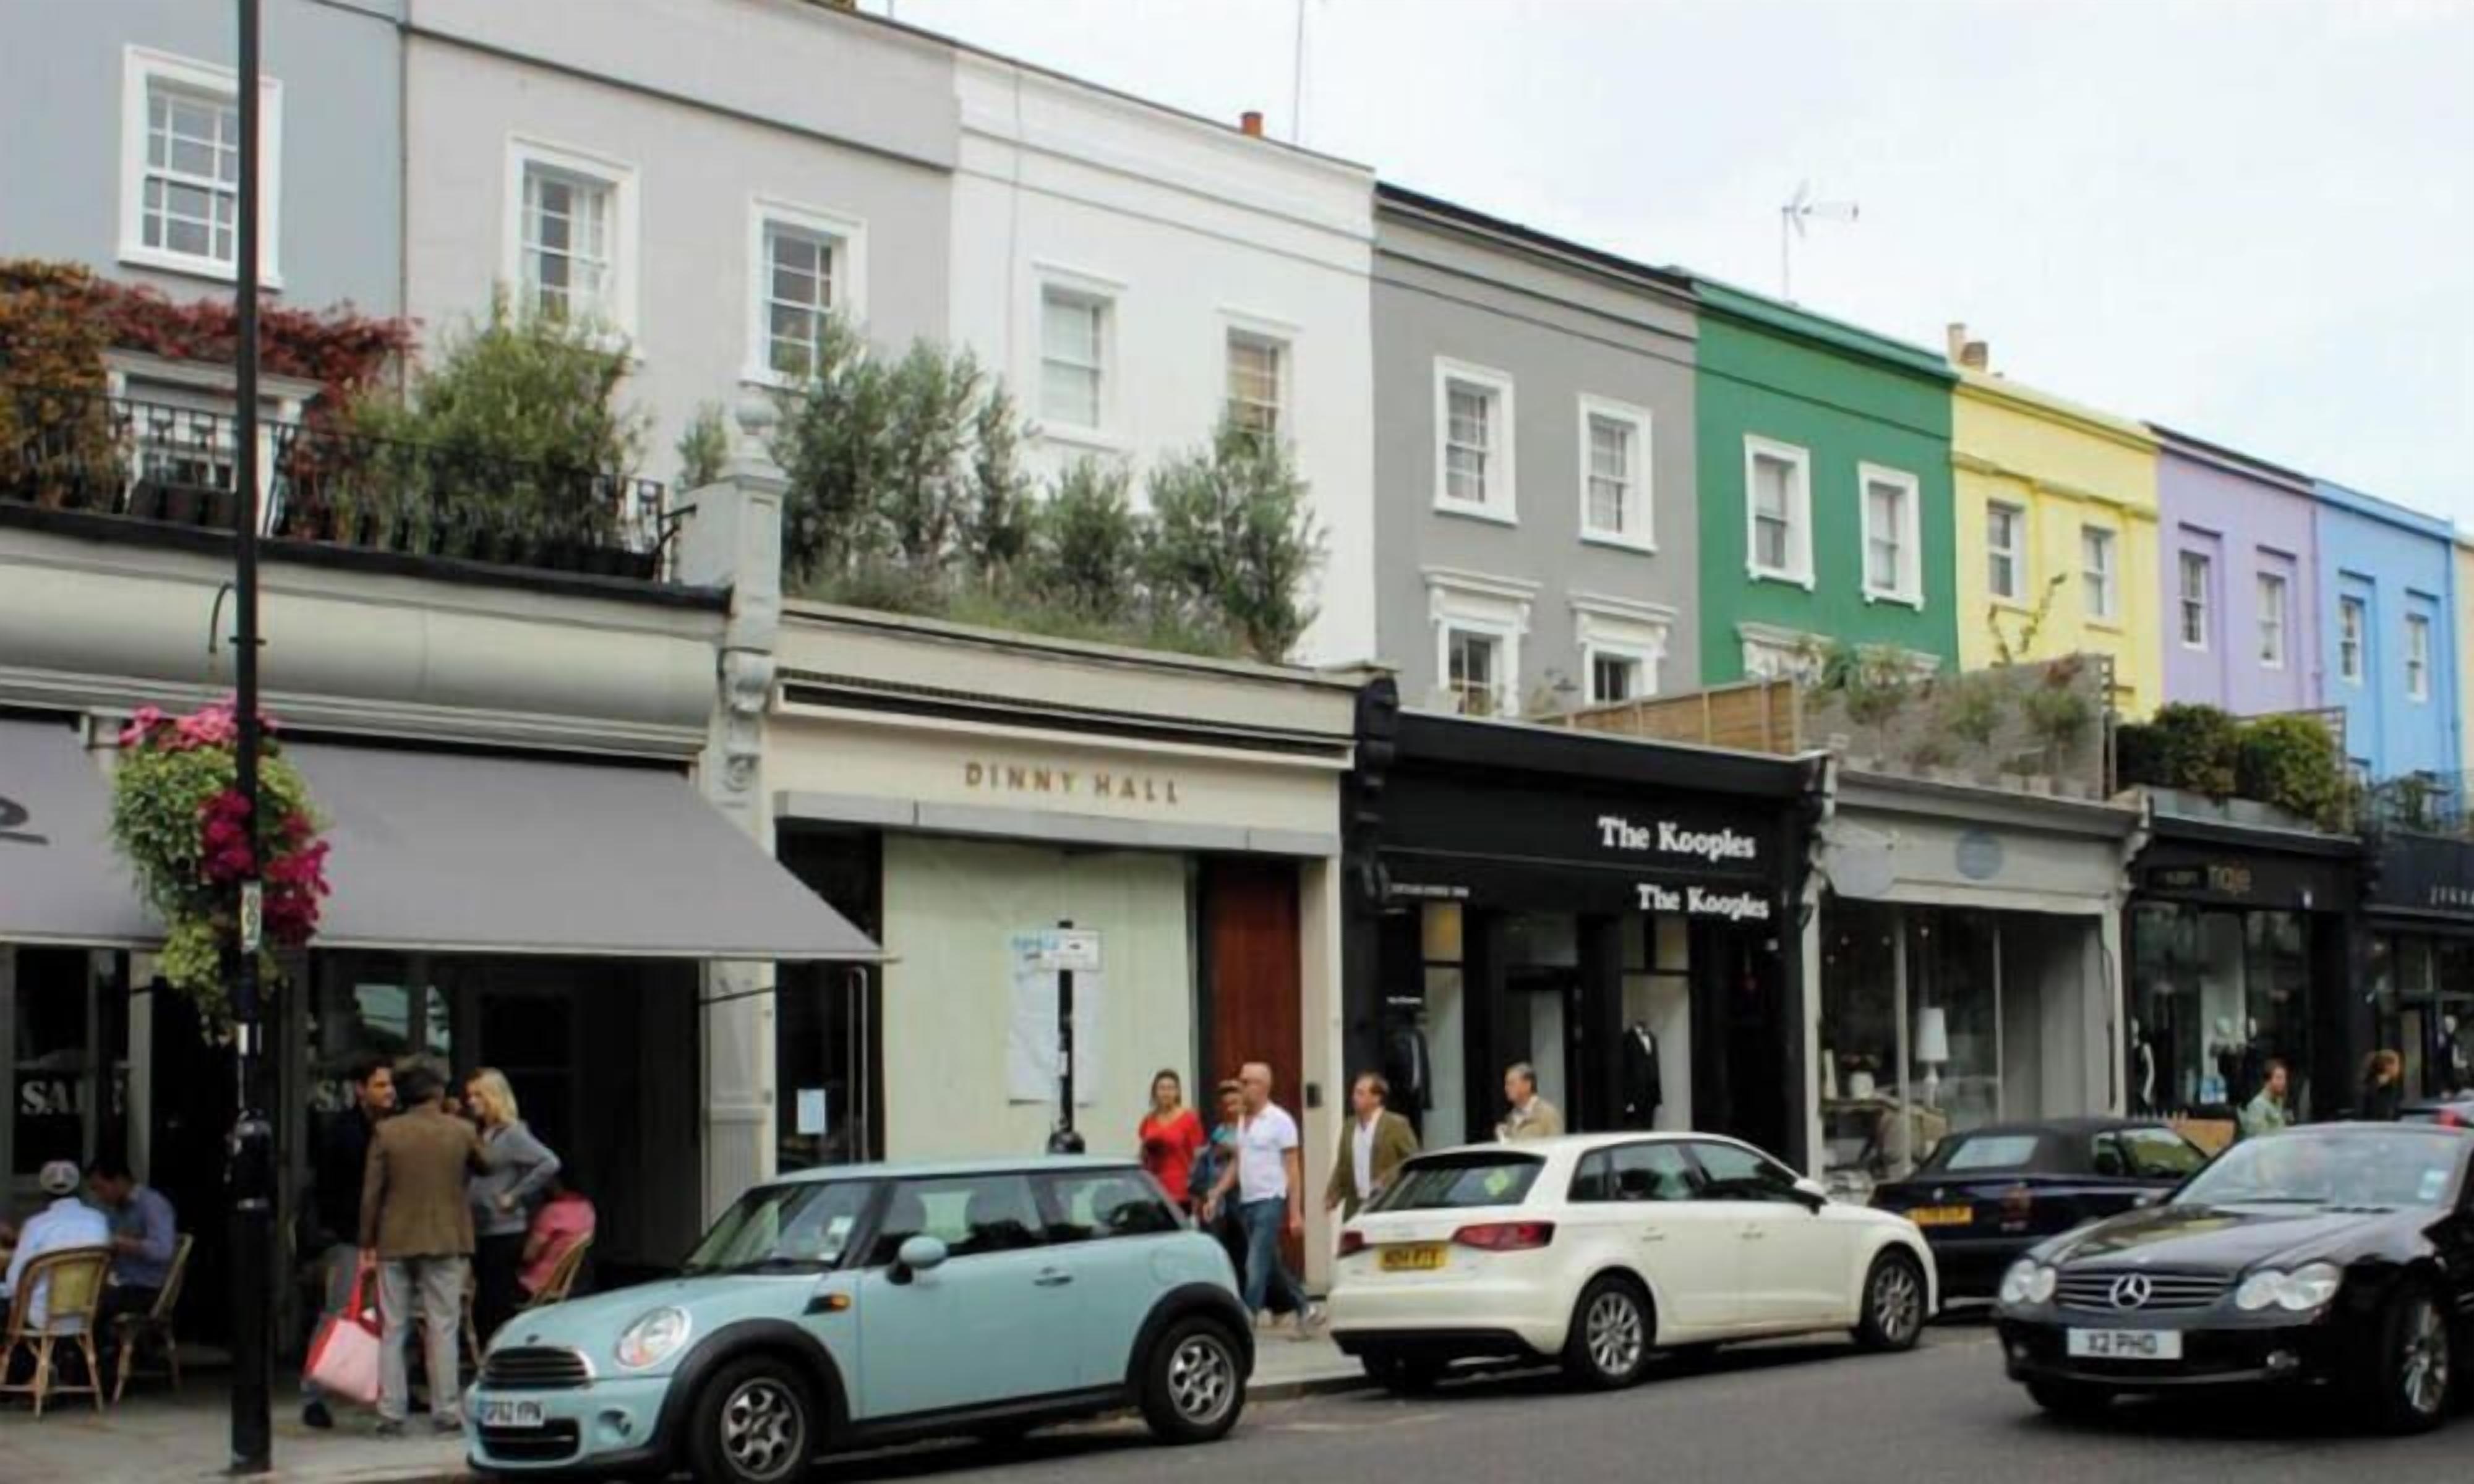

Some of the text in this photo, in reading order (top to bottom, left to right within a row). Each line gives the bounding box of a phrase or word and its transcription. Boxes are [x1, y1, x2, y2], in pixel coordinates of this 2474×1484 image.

[965, 762, 1178, 804] DINNY HALL
[1598, 816, 1755, 863] The Kooples
[1637, 884, 1768, 921] The Kooples
